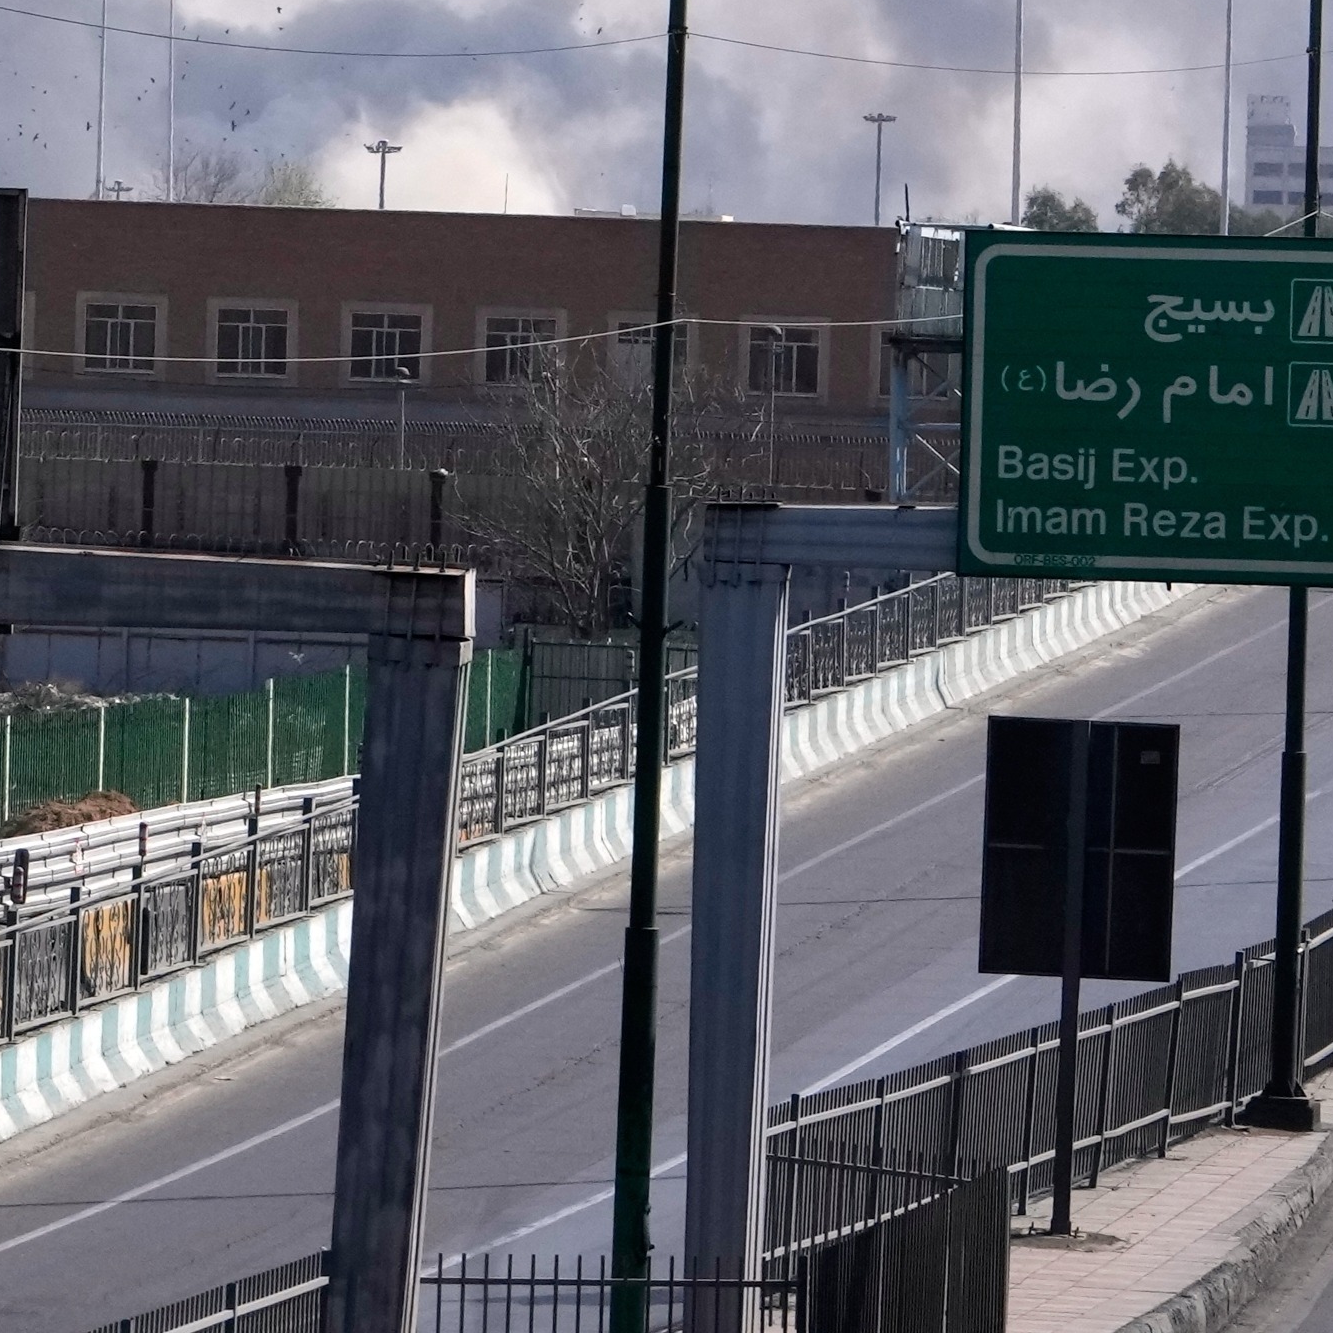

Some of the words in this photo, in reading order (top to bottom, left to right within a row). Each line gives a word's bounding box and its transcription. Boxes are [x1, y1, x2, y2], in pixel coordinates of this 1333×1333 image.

[1144, 294, 1275, 342] بسیج
[1055, 361, 1141, 420] رضا
[1163, 365, 1274, 423] امام
[997, 444, 1096, 490] Basij
[1112, 447, 1198, 491] Exp.
[996, 499, 1107, 535] Imam
[1123, 502, 1226, 539] Reza
[1242, 505, 1329, 548] Exp.
